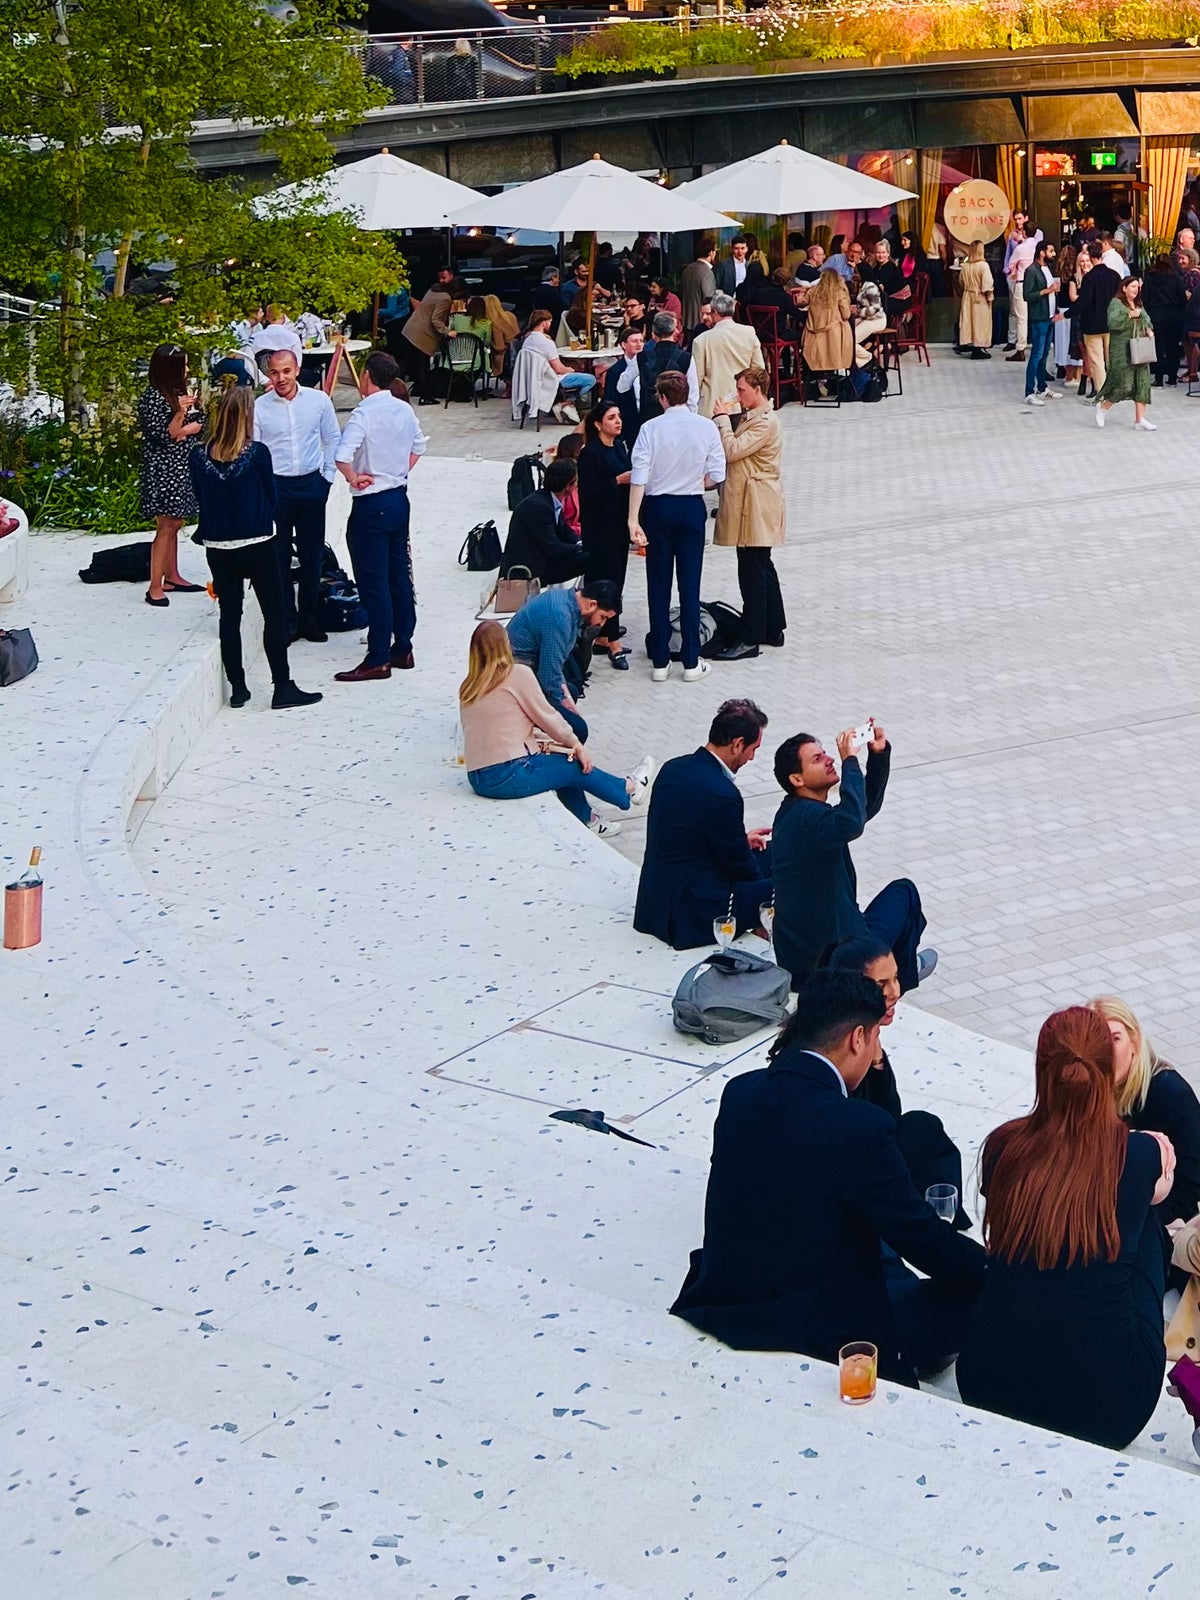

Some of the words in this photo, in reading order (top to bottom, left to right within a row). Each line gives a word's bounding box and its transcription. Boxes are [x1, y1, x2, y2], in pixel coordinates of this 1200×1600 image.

[959, 197, 994, 208] BACK
[950, 215, 969, 226] TO
[974, 215, 1004, 226] MINE
